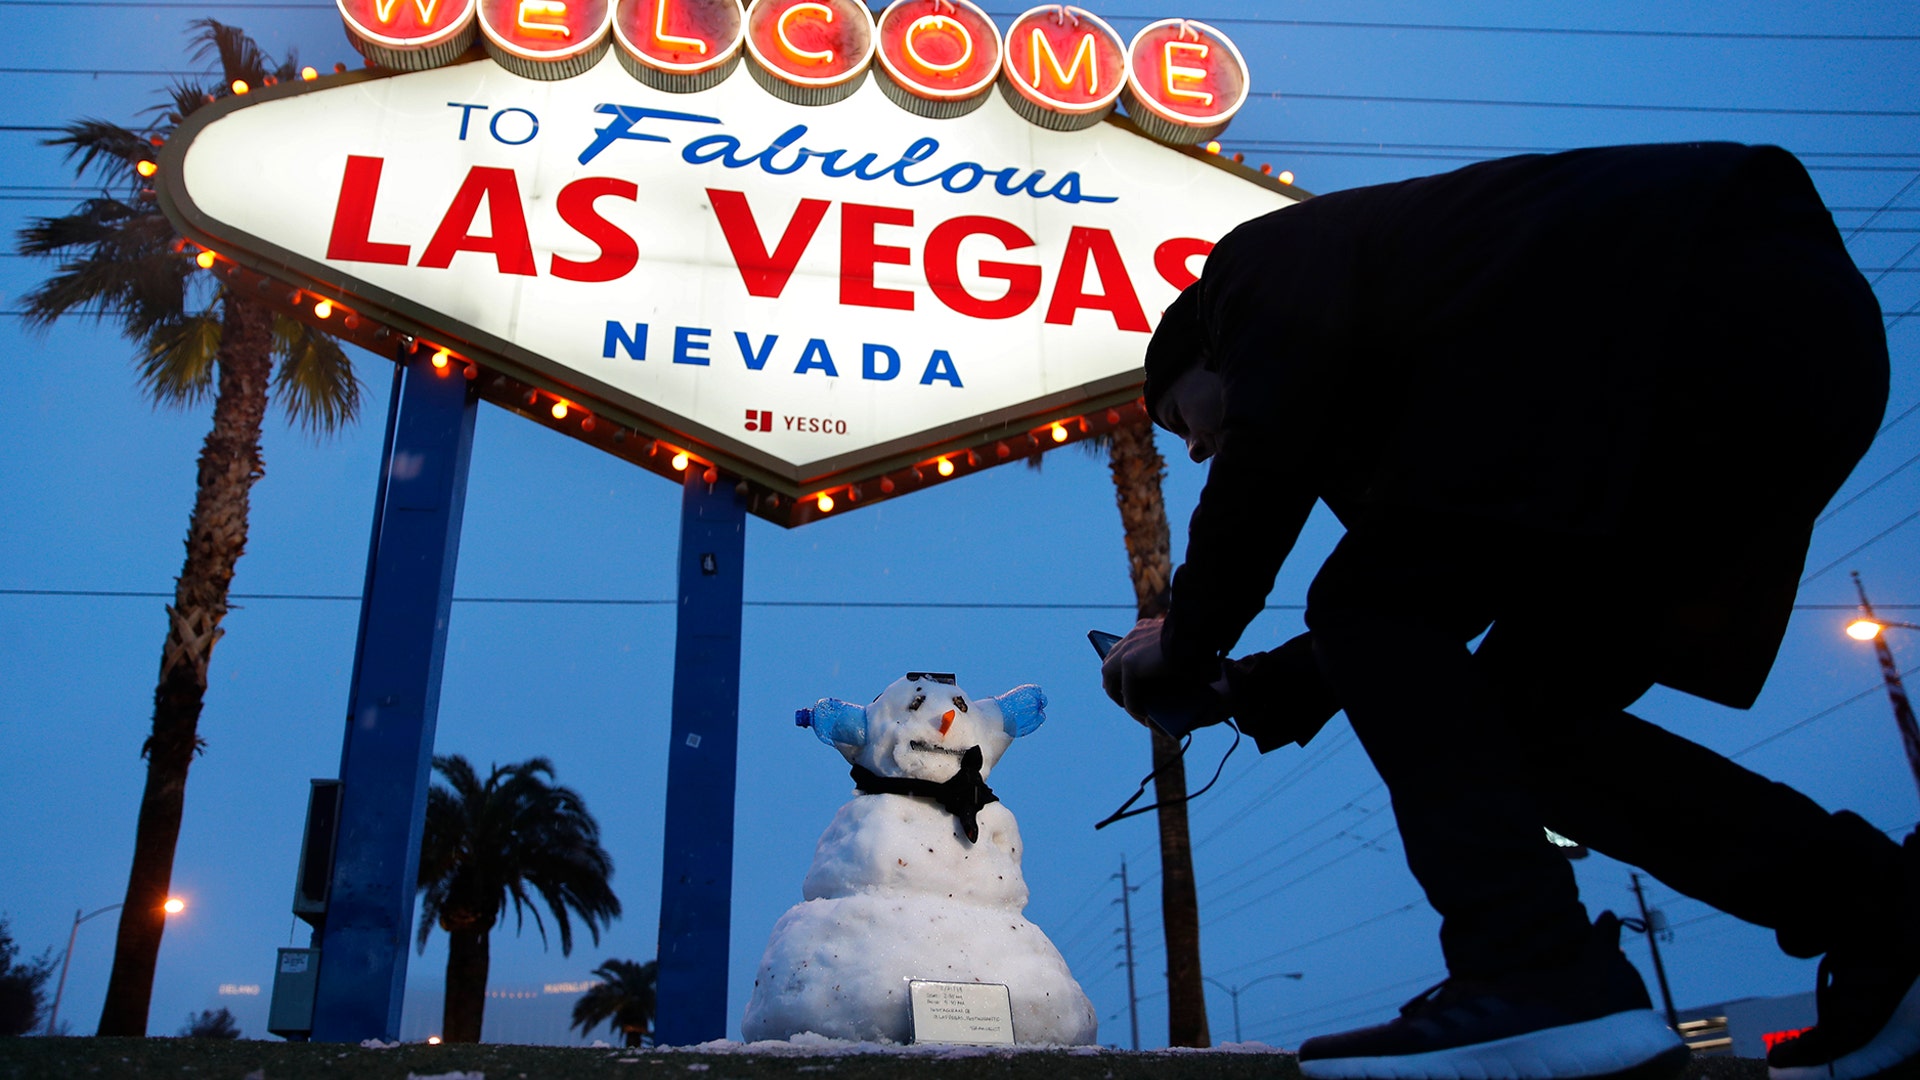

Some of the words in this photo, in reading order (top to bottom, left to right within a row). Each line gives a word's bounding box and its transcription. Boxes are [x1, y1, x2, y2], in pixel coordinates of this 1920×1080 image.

[447, 102, 539, 145] TO
[579, 103, 1118, 204] Fabulous
[326, 156, 640, 283] LAS
[603, 321, 963, 387] NEVADA
[784, 415, 847, 435] YESCO
